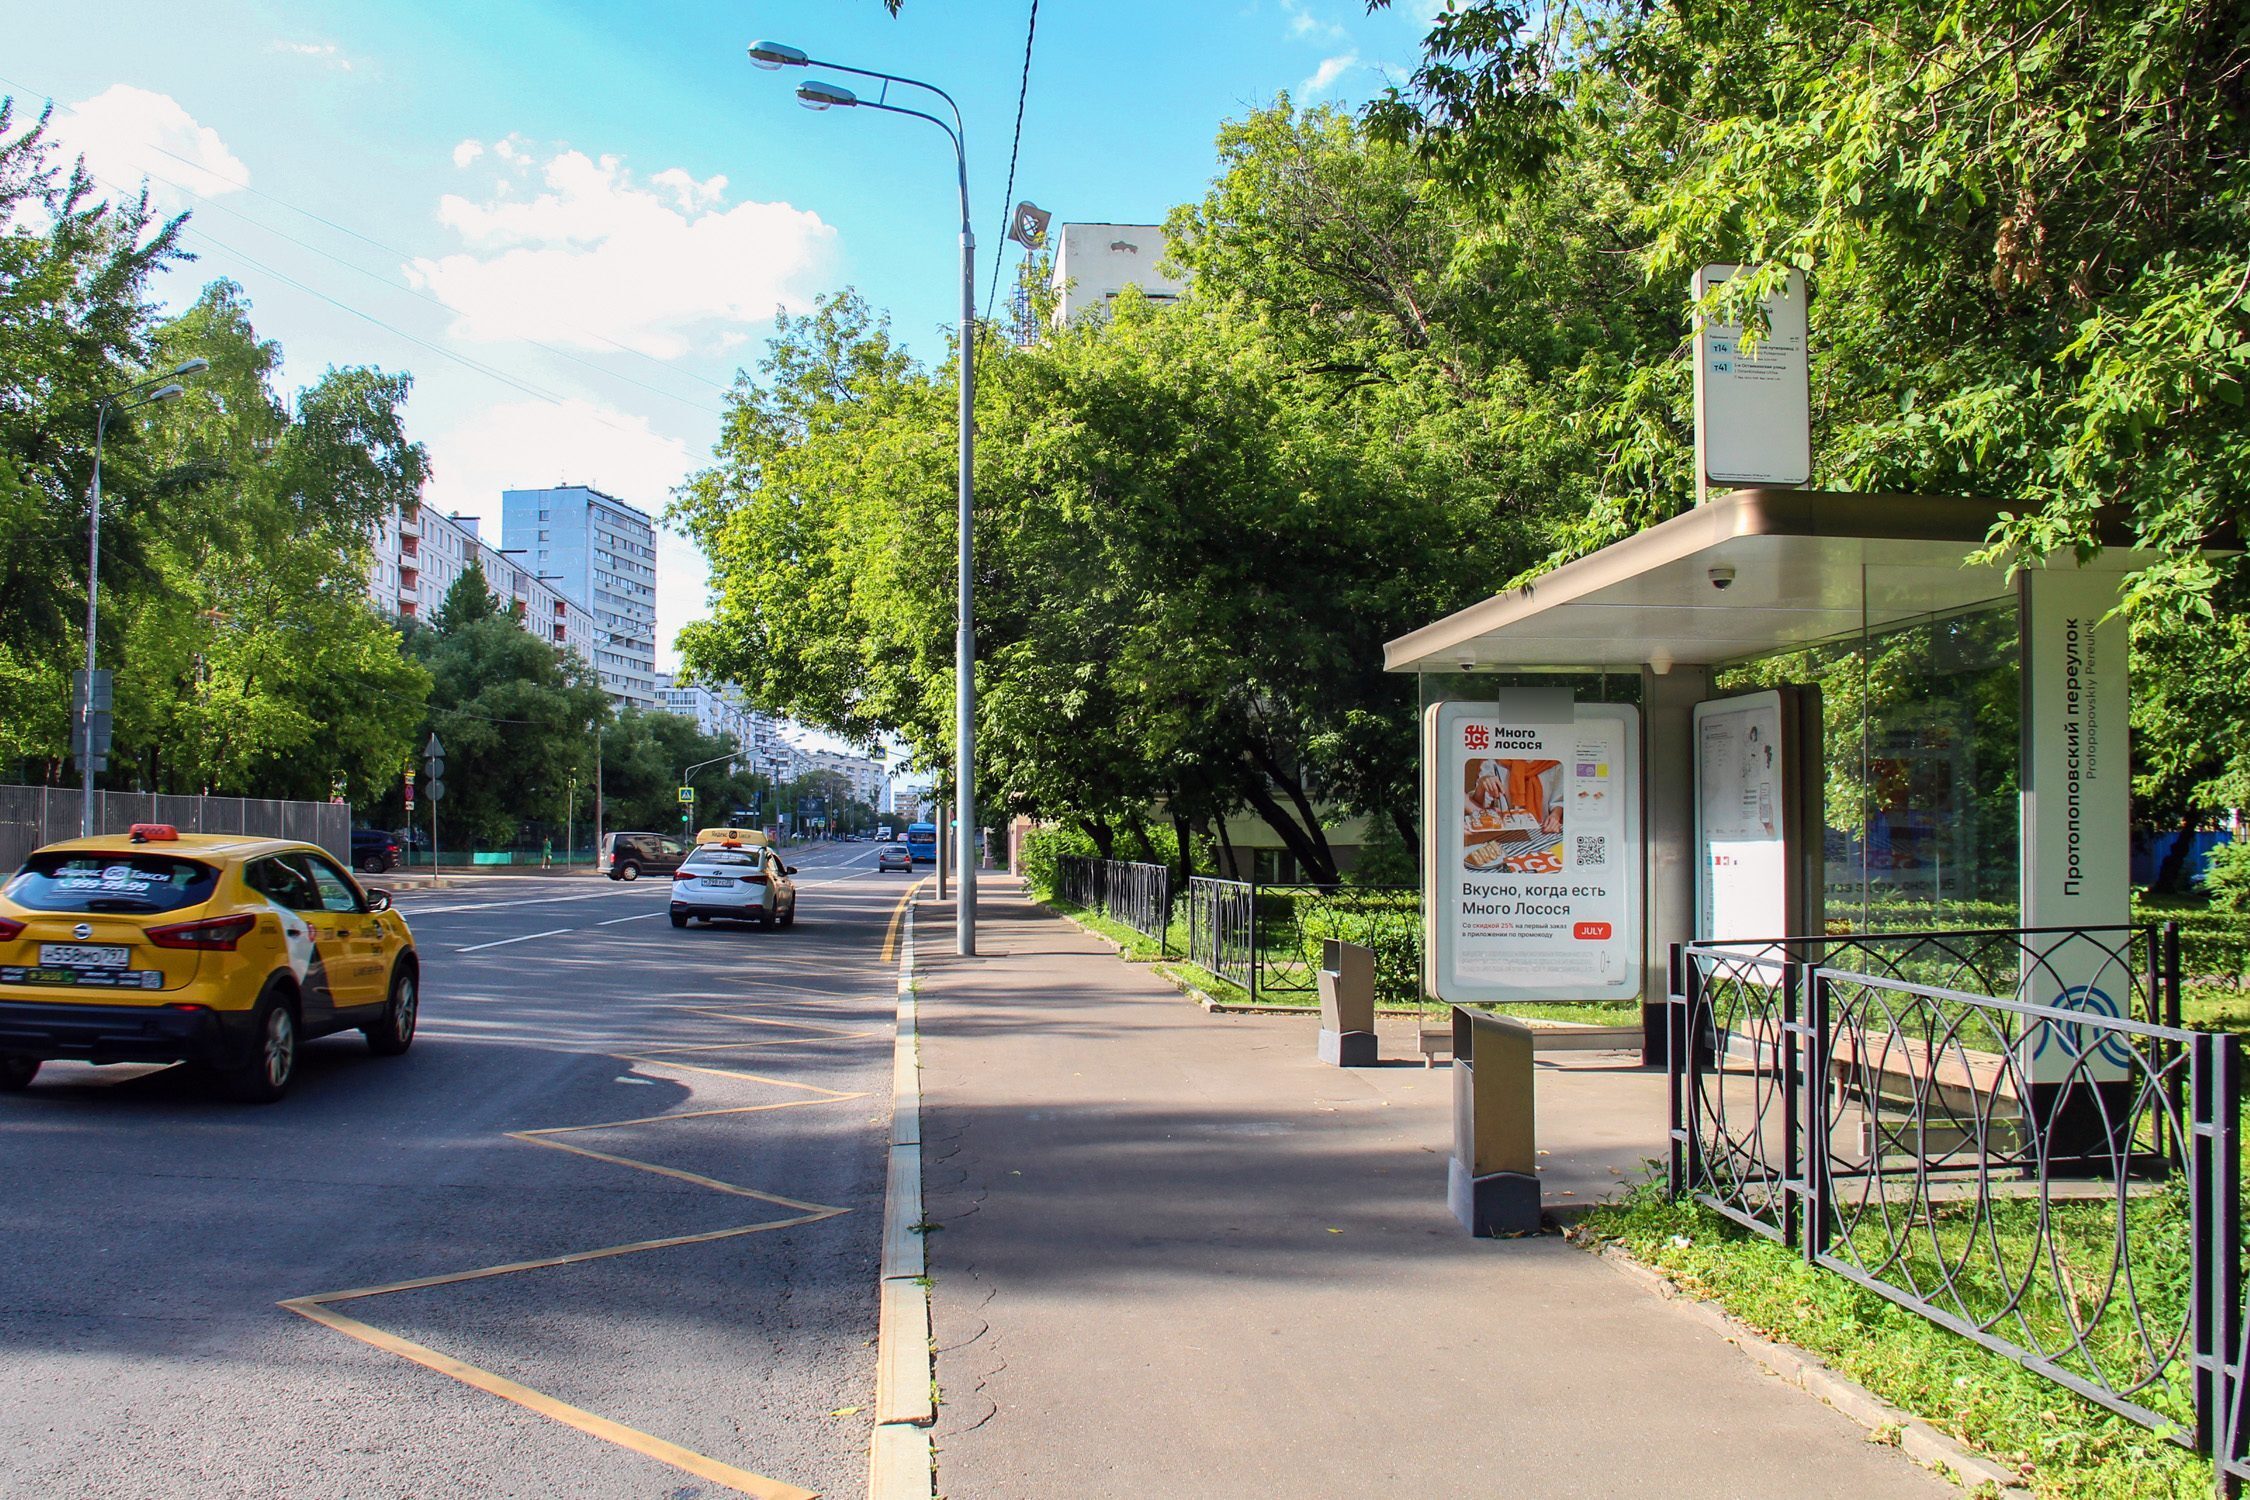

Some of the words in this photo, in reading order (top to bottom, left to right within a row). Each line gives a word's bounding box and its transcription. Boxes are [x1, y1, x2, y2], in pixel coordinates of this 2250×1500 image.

[1713, 344, 1728, 352] т14
[2066, 618, 2082, 715] переулок
[1494, 727, 1536, 738] Много
[2085, 679, 2098, 779] Protopopovskiy
[1494, 740, 1543, 750] лосося
[2064, 723, 2083, 896] Протопоповский
[131, 869, 171, 881] Такси
[70, 879, 151, 891] 999-99-99
[1462, 882, 1521, 898] Вкусно,
[1525, 885, 1568, 898] когда
[1571, 885, 1606, 897] есть
[1462, 902, 1511, 915] Много
[1514, 902, 1571, 915] Лосося
[1472, 922, 1500, 930] скидкой
[1581, 927, 1604, 936] JULY
